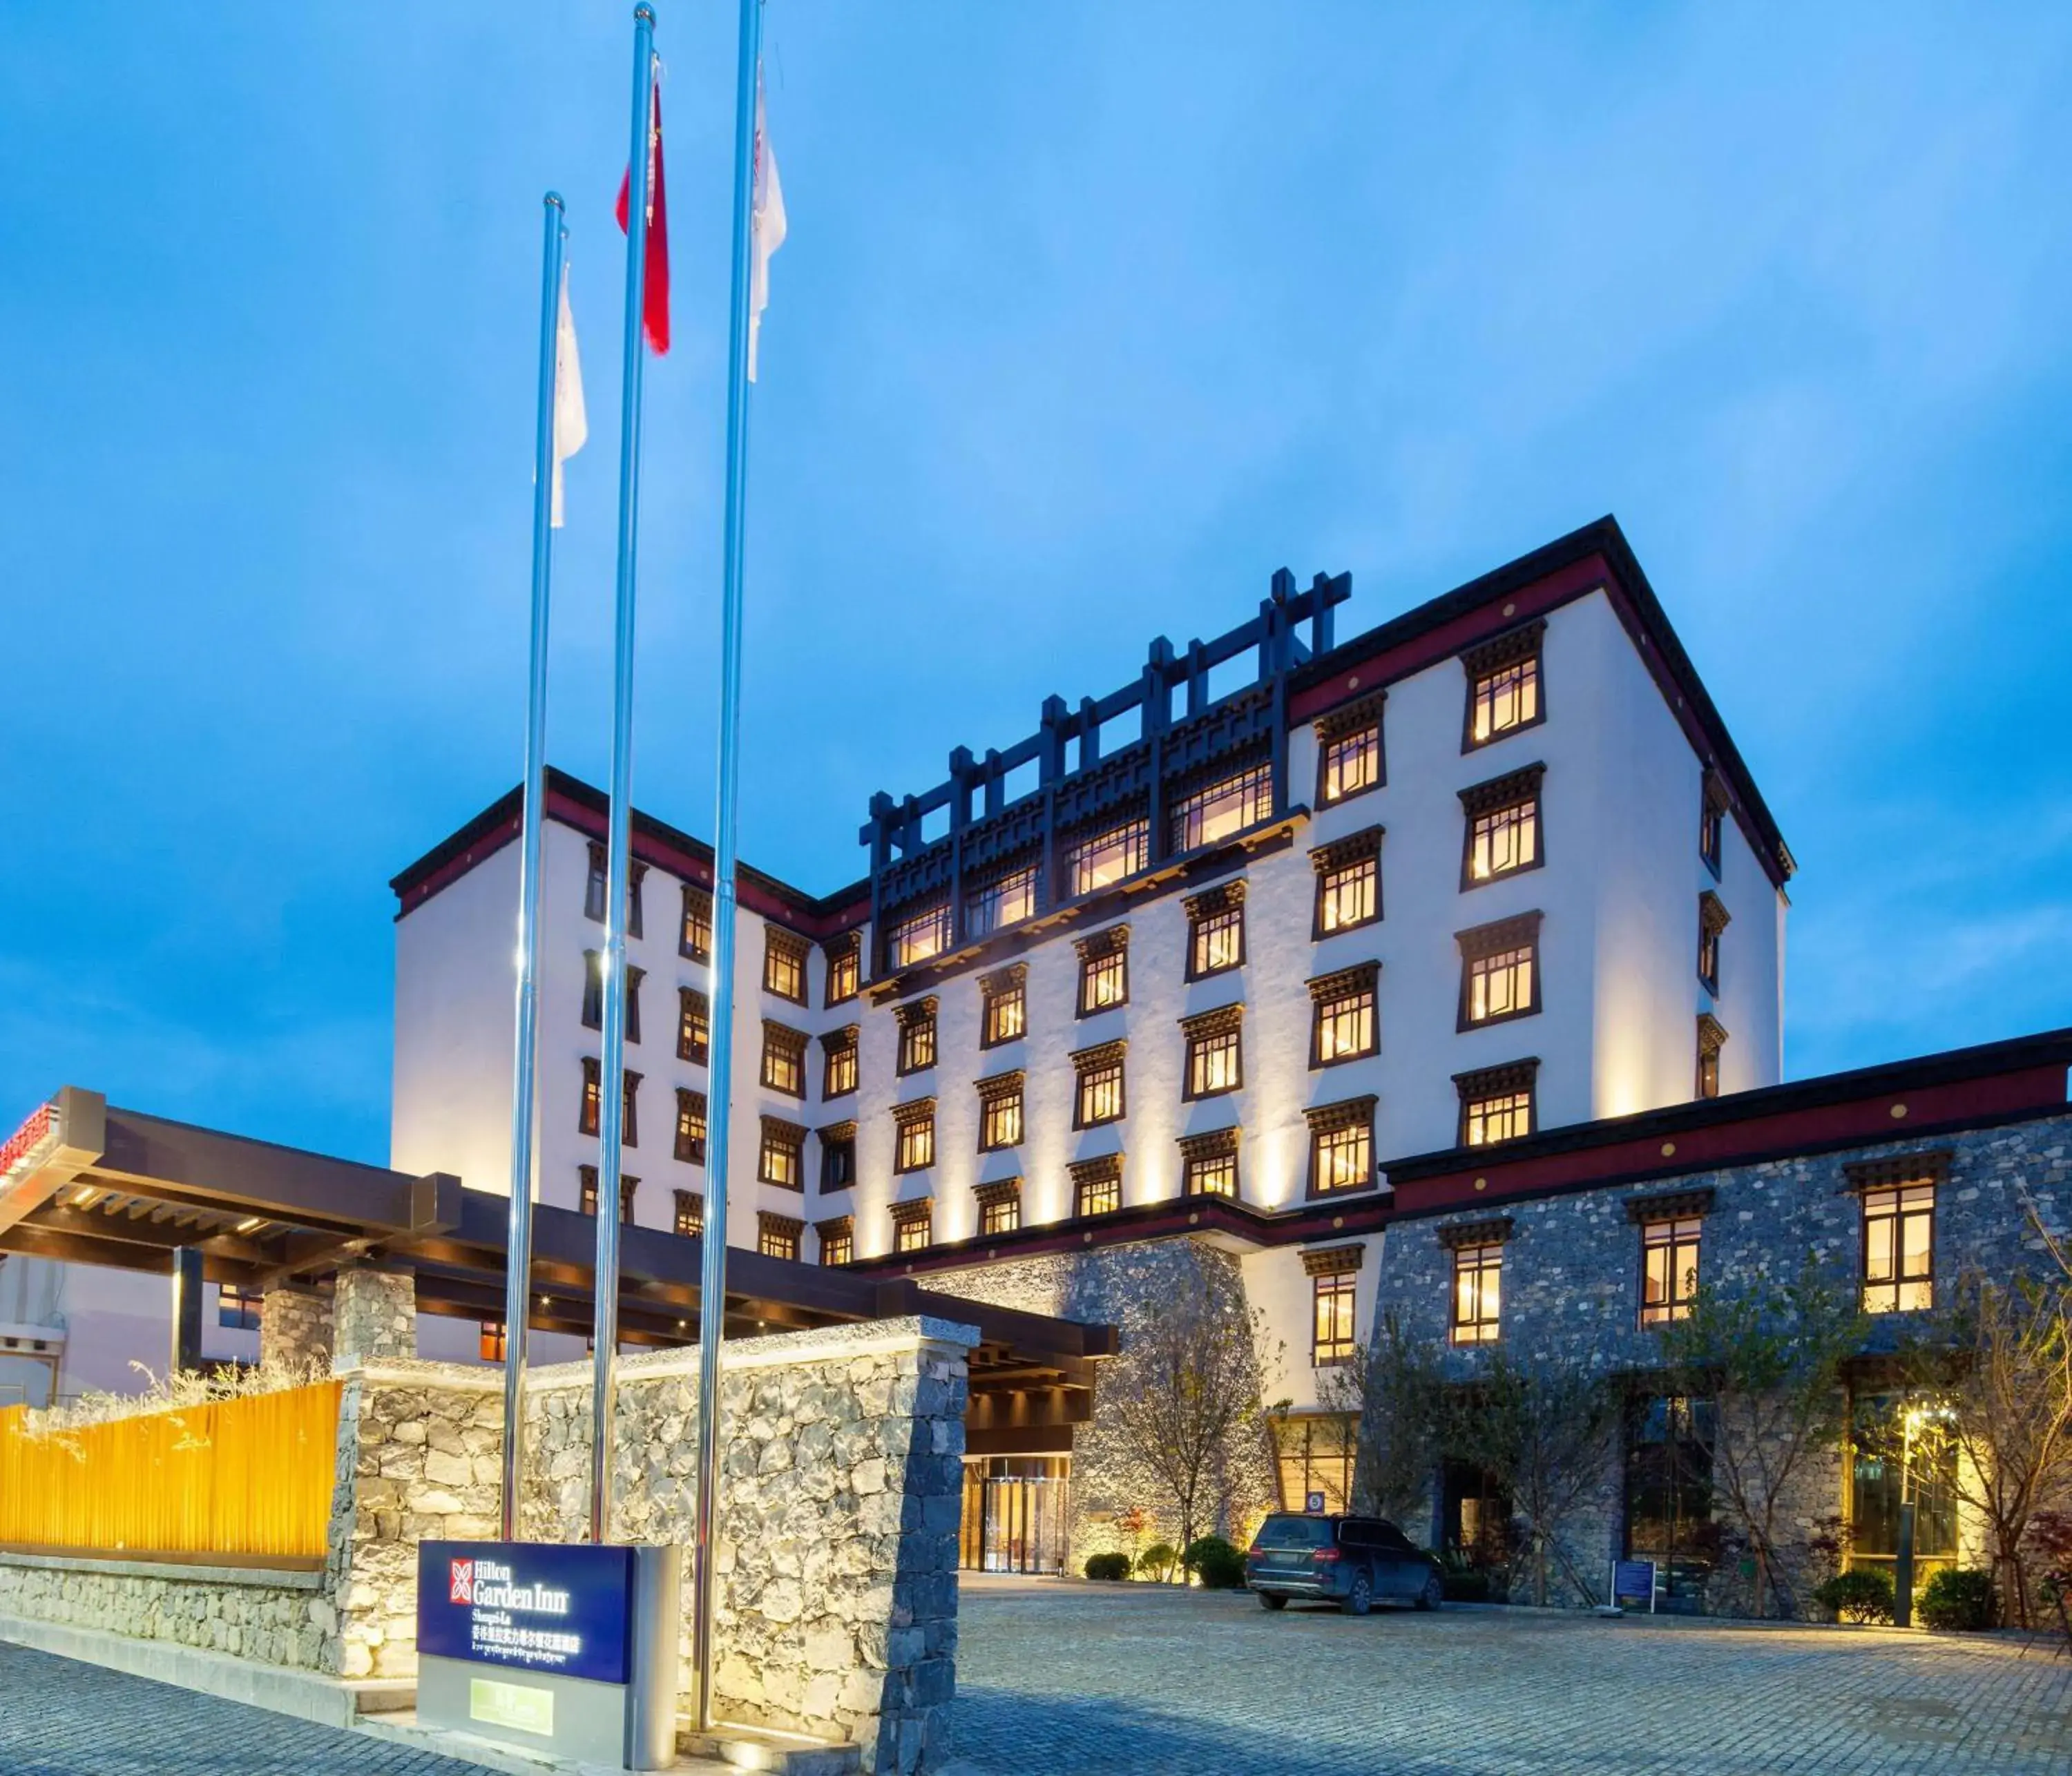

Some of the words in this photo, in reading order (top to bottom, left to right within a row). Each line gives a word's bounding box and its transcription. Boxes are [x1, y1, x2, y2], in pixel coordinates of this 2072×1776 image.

[474, 1561, 510, 1581] Hilton
[473, 1580, 533, 1610] Garden
[534, 1583, 568, 1614] Inn
